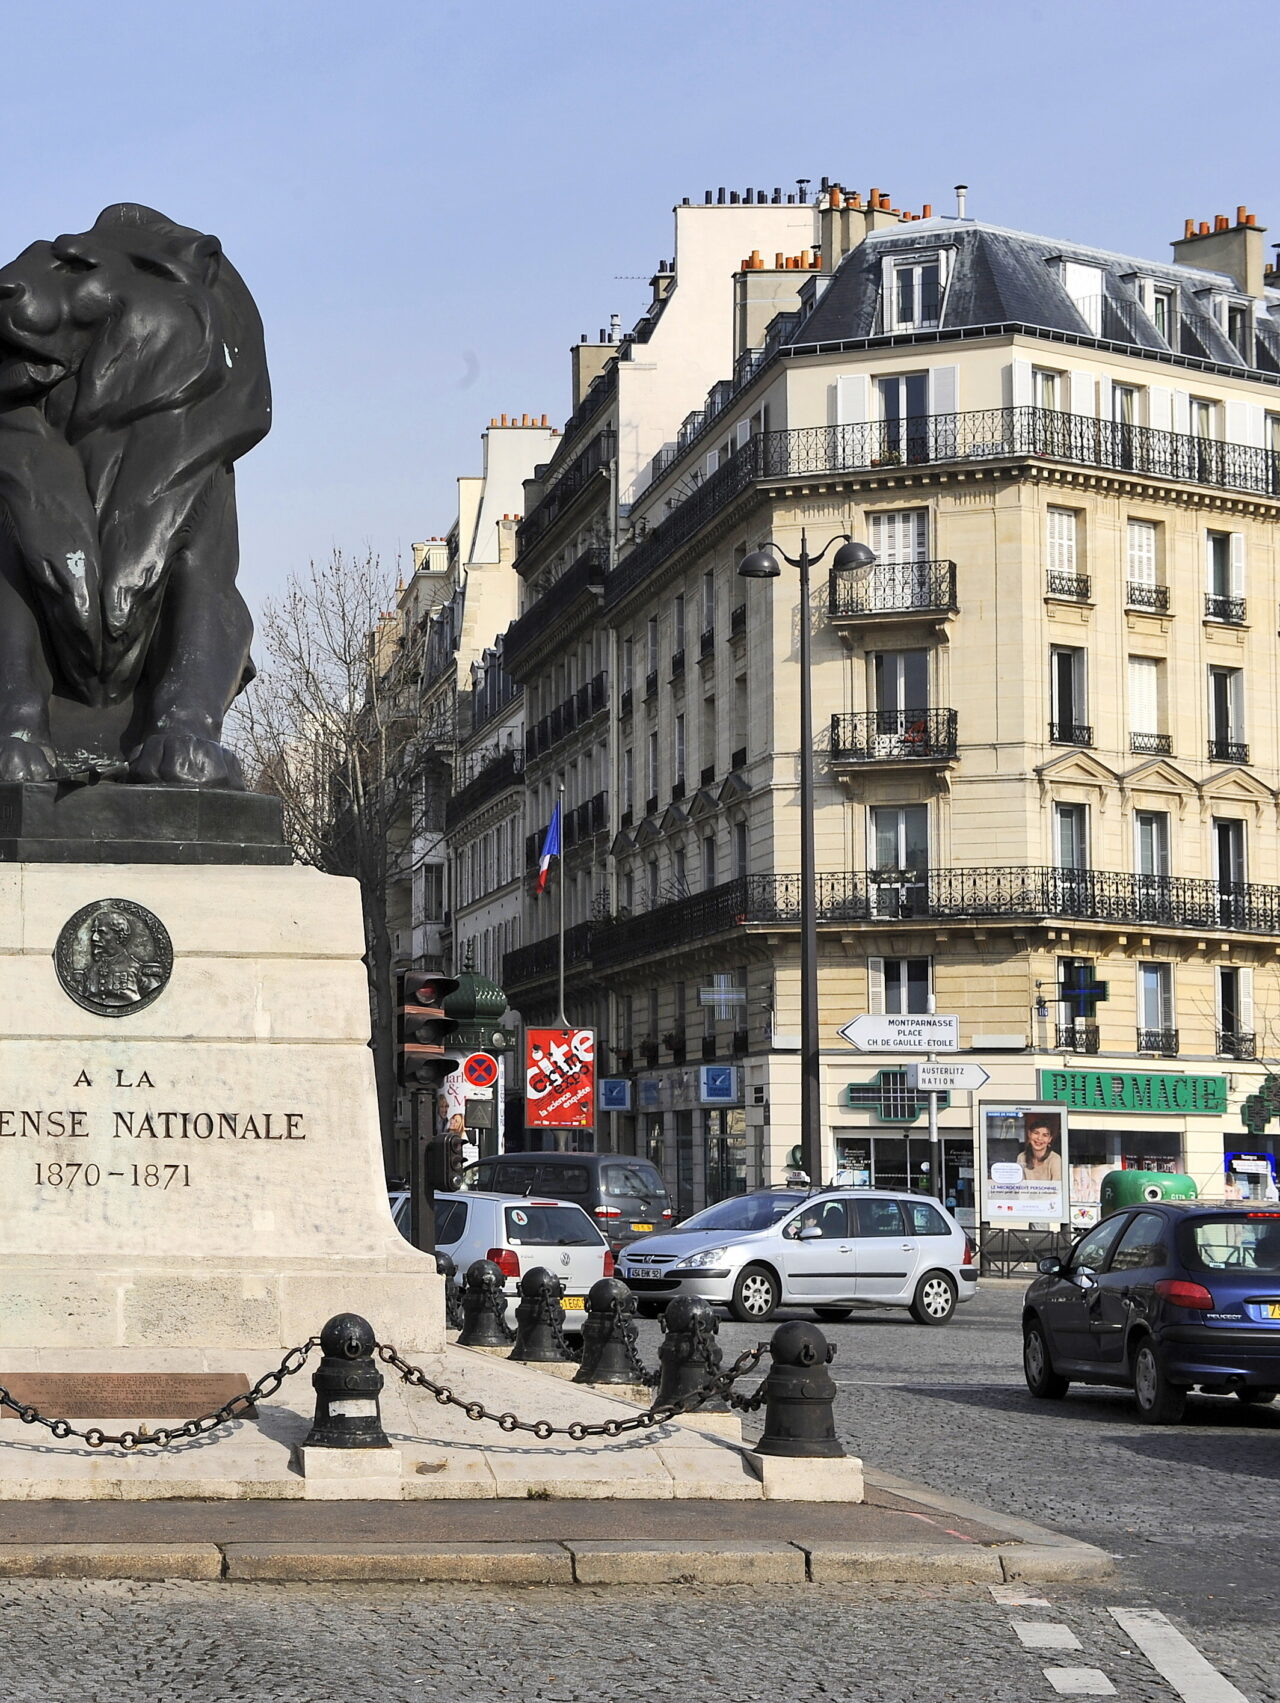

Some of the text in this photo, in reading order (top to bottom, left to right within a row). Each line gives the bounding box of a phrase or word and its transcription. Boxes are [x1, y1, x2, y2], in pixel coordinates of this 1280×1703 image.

[888, 1019, 953, 1027] MONTPARNASSE
[897, 1029, 923, 1037] PLACE
[881, 1039, 891, 1047] DE
[921, 1067, 965, 1075] AUSTERLITZ
[73, 1069, 156, 1088] A LA
[554, 1065, 590, 1094] expo
[1051, 1073, 1220, 1111] PHARMACIE
[112, 1110, 306, 1140] NATIONALE
